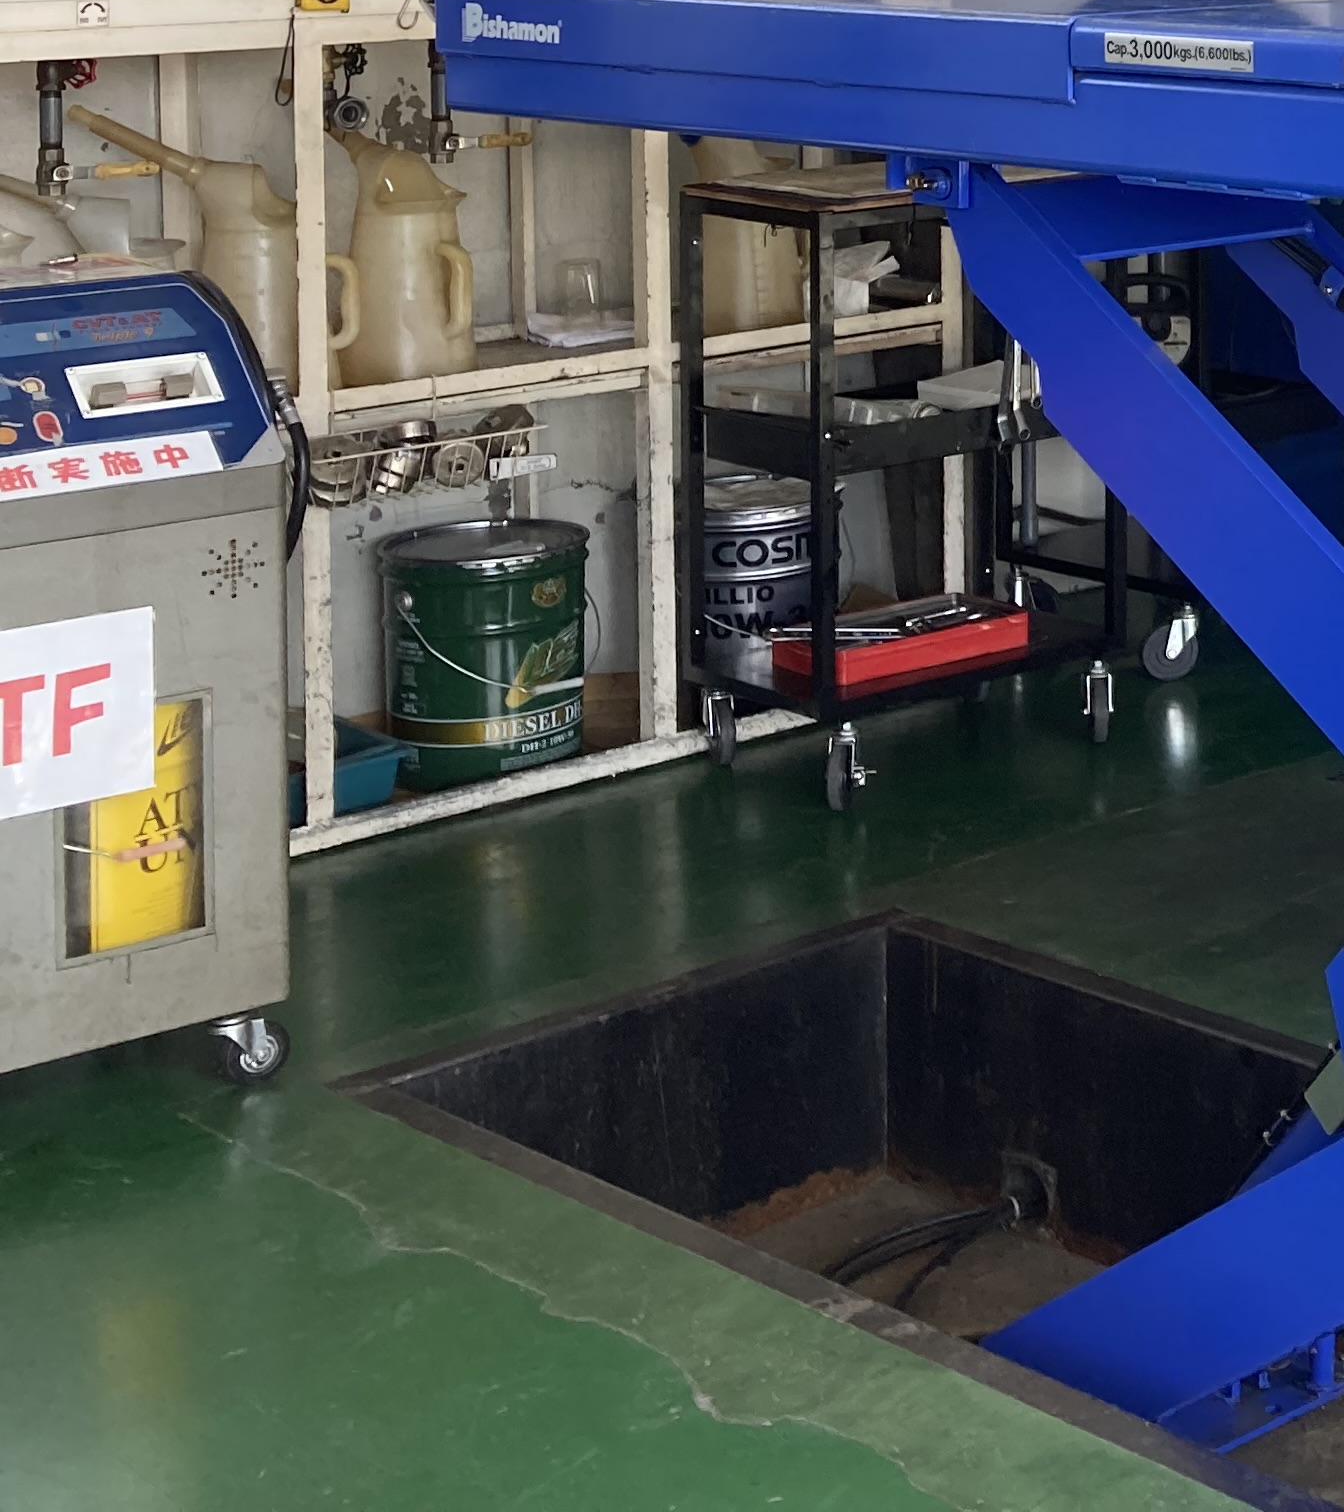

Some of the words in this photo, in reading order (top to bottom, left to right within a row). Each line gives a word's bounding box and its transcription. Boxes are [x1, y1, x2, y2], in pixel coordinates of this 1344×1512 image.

[461, 1, 562, 44] Bishamon
[704, 585, 775, 606] ILLIO
[484, 714, 562, 742] DIESEL
